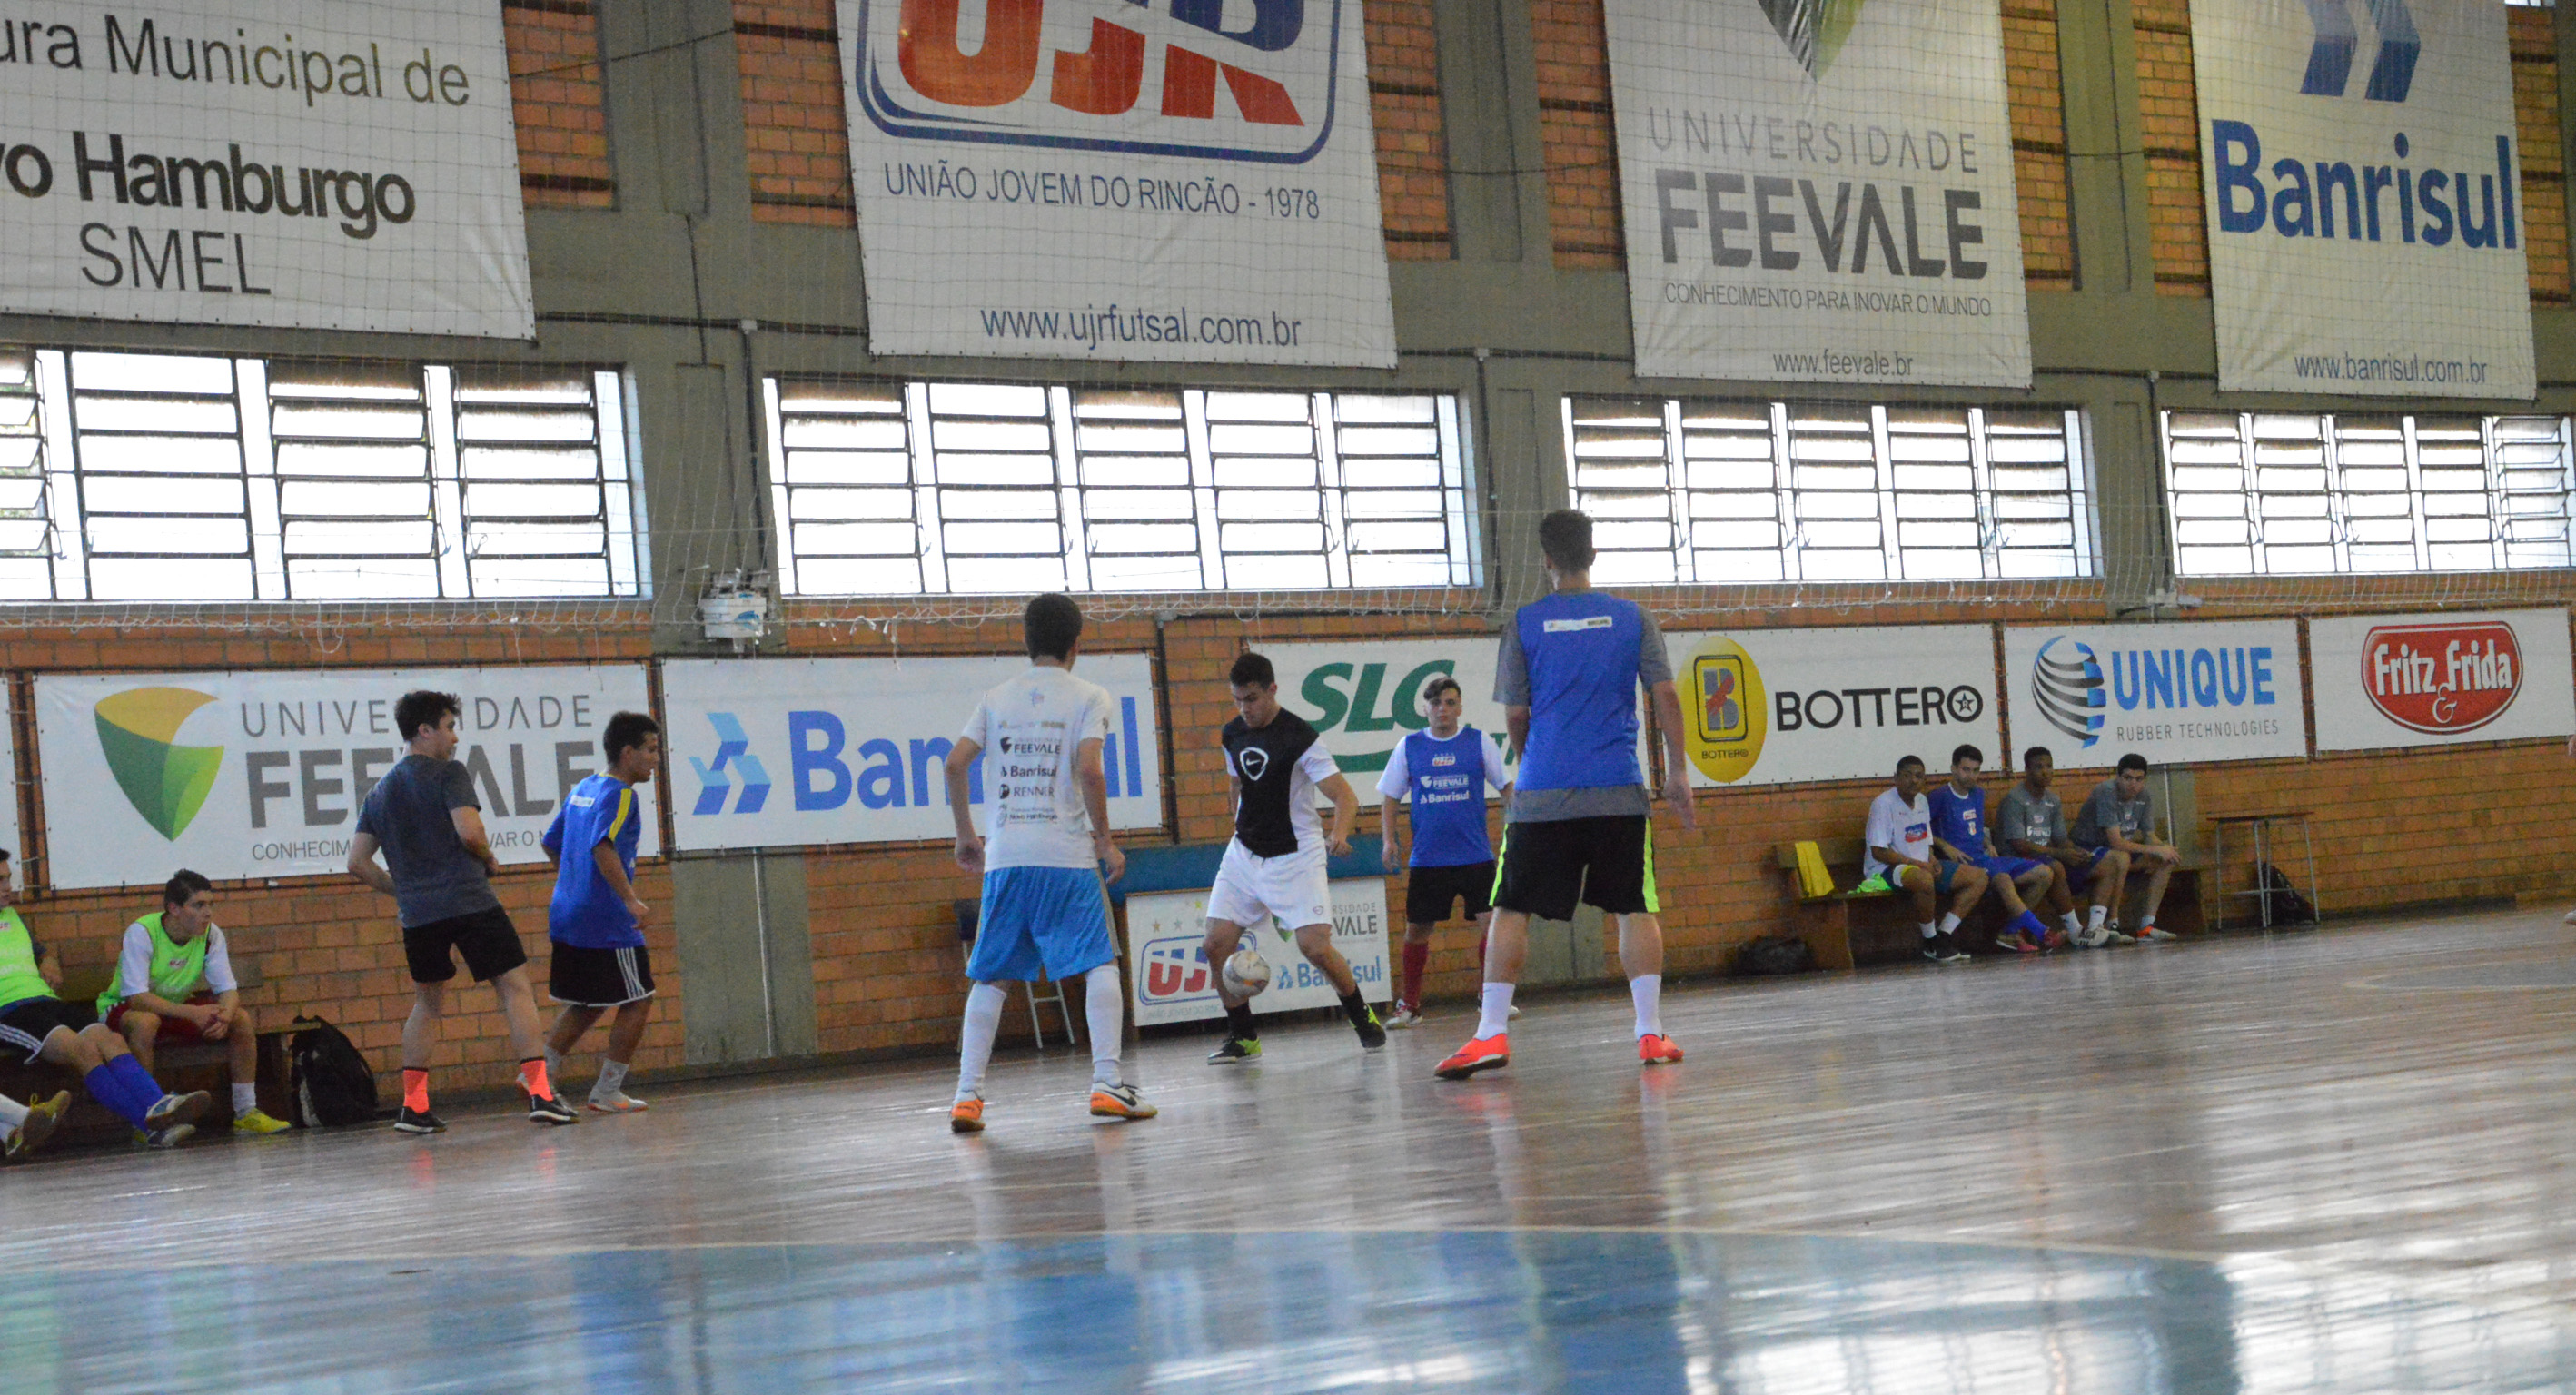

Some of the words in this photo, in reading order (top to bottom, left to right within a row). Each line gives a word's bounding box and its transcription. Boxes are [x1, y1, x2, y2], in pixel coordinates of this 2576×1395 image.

[104, 14, 382, 106] Municipal
[404, 48, 470, 106] de
[1648, 107, 1978, 173] UNIVERSIDADE
[73, 130, 415, 239] Hamburgo
[885, 159, 976, 199] UNIÃO
[986, 169, 1082, 205] JOVEM
[1091, 174, 1130, 208] DO
[1264, 187, 1320, 219] 1978
[2212, 119, 2517, 249] Banrisul
[1655, 168, 1988, 280] FEEVALE
[79, 223, 271, 294] SMEL
[1665, 282, 1802, 309] CONHECIMENTO
[1807, 289, 1850, 312] PARA
[1854, 292, 1913, 313] INOVAR
[1917, 295, 1929, 314] O
[1932, 296, 1992, 317] MUNDO
[980, 304, 1302, 351] www.ujrfutsal.com.br
[1772, 349, 1914, 377] www.feevale.br
[2294, 351, 2487, 384] www.banrisul.com.br
[2112, 647, 2275, 710] UNIQUE
[2374, 643, 2436, 696] Fritz
[2445, 638, 2512, 692] Frida
[1775, 685, 1984, 732] BOTTERO
[2117, 724, 2172, 741] RUBBER
[2178, 719, 2279, 739] TECHNOLOGIES
[1010, 765, 1057, 778] Banrisul
[1014, 743, 1061, 755] FEEVALE
[1701, 749, 1749, 760] BOTTERO
